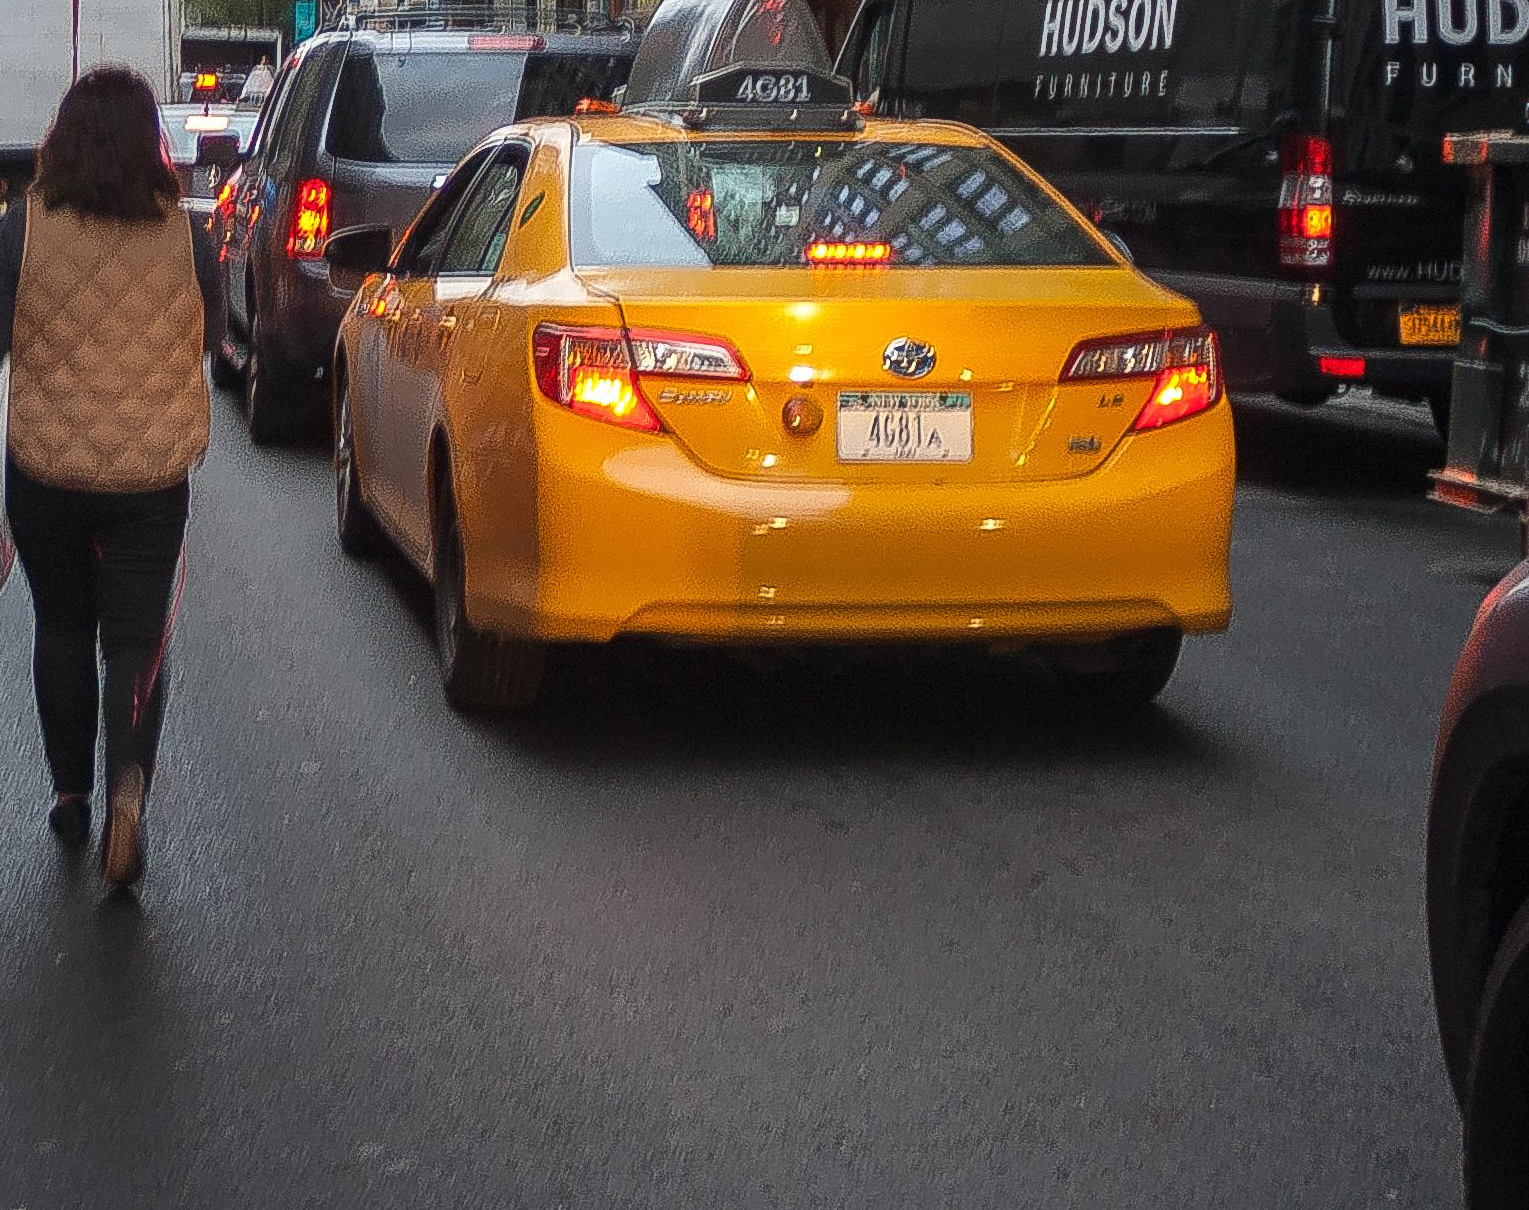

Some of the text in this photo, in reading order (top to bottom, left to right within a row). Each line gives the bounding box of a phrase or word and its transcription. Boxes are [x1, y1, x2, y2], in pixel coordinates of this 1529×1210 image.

[735, 74, 811, 102] 4G81
[1033, 70, 1168, 99] FURNITURE
[1385, 61, 1512, 87] FURN
